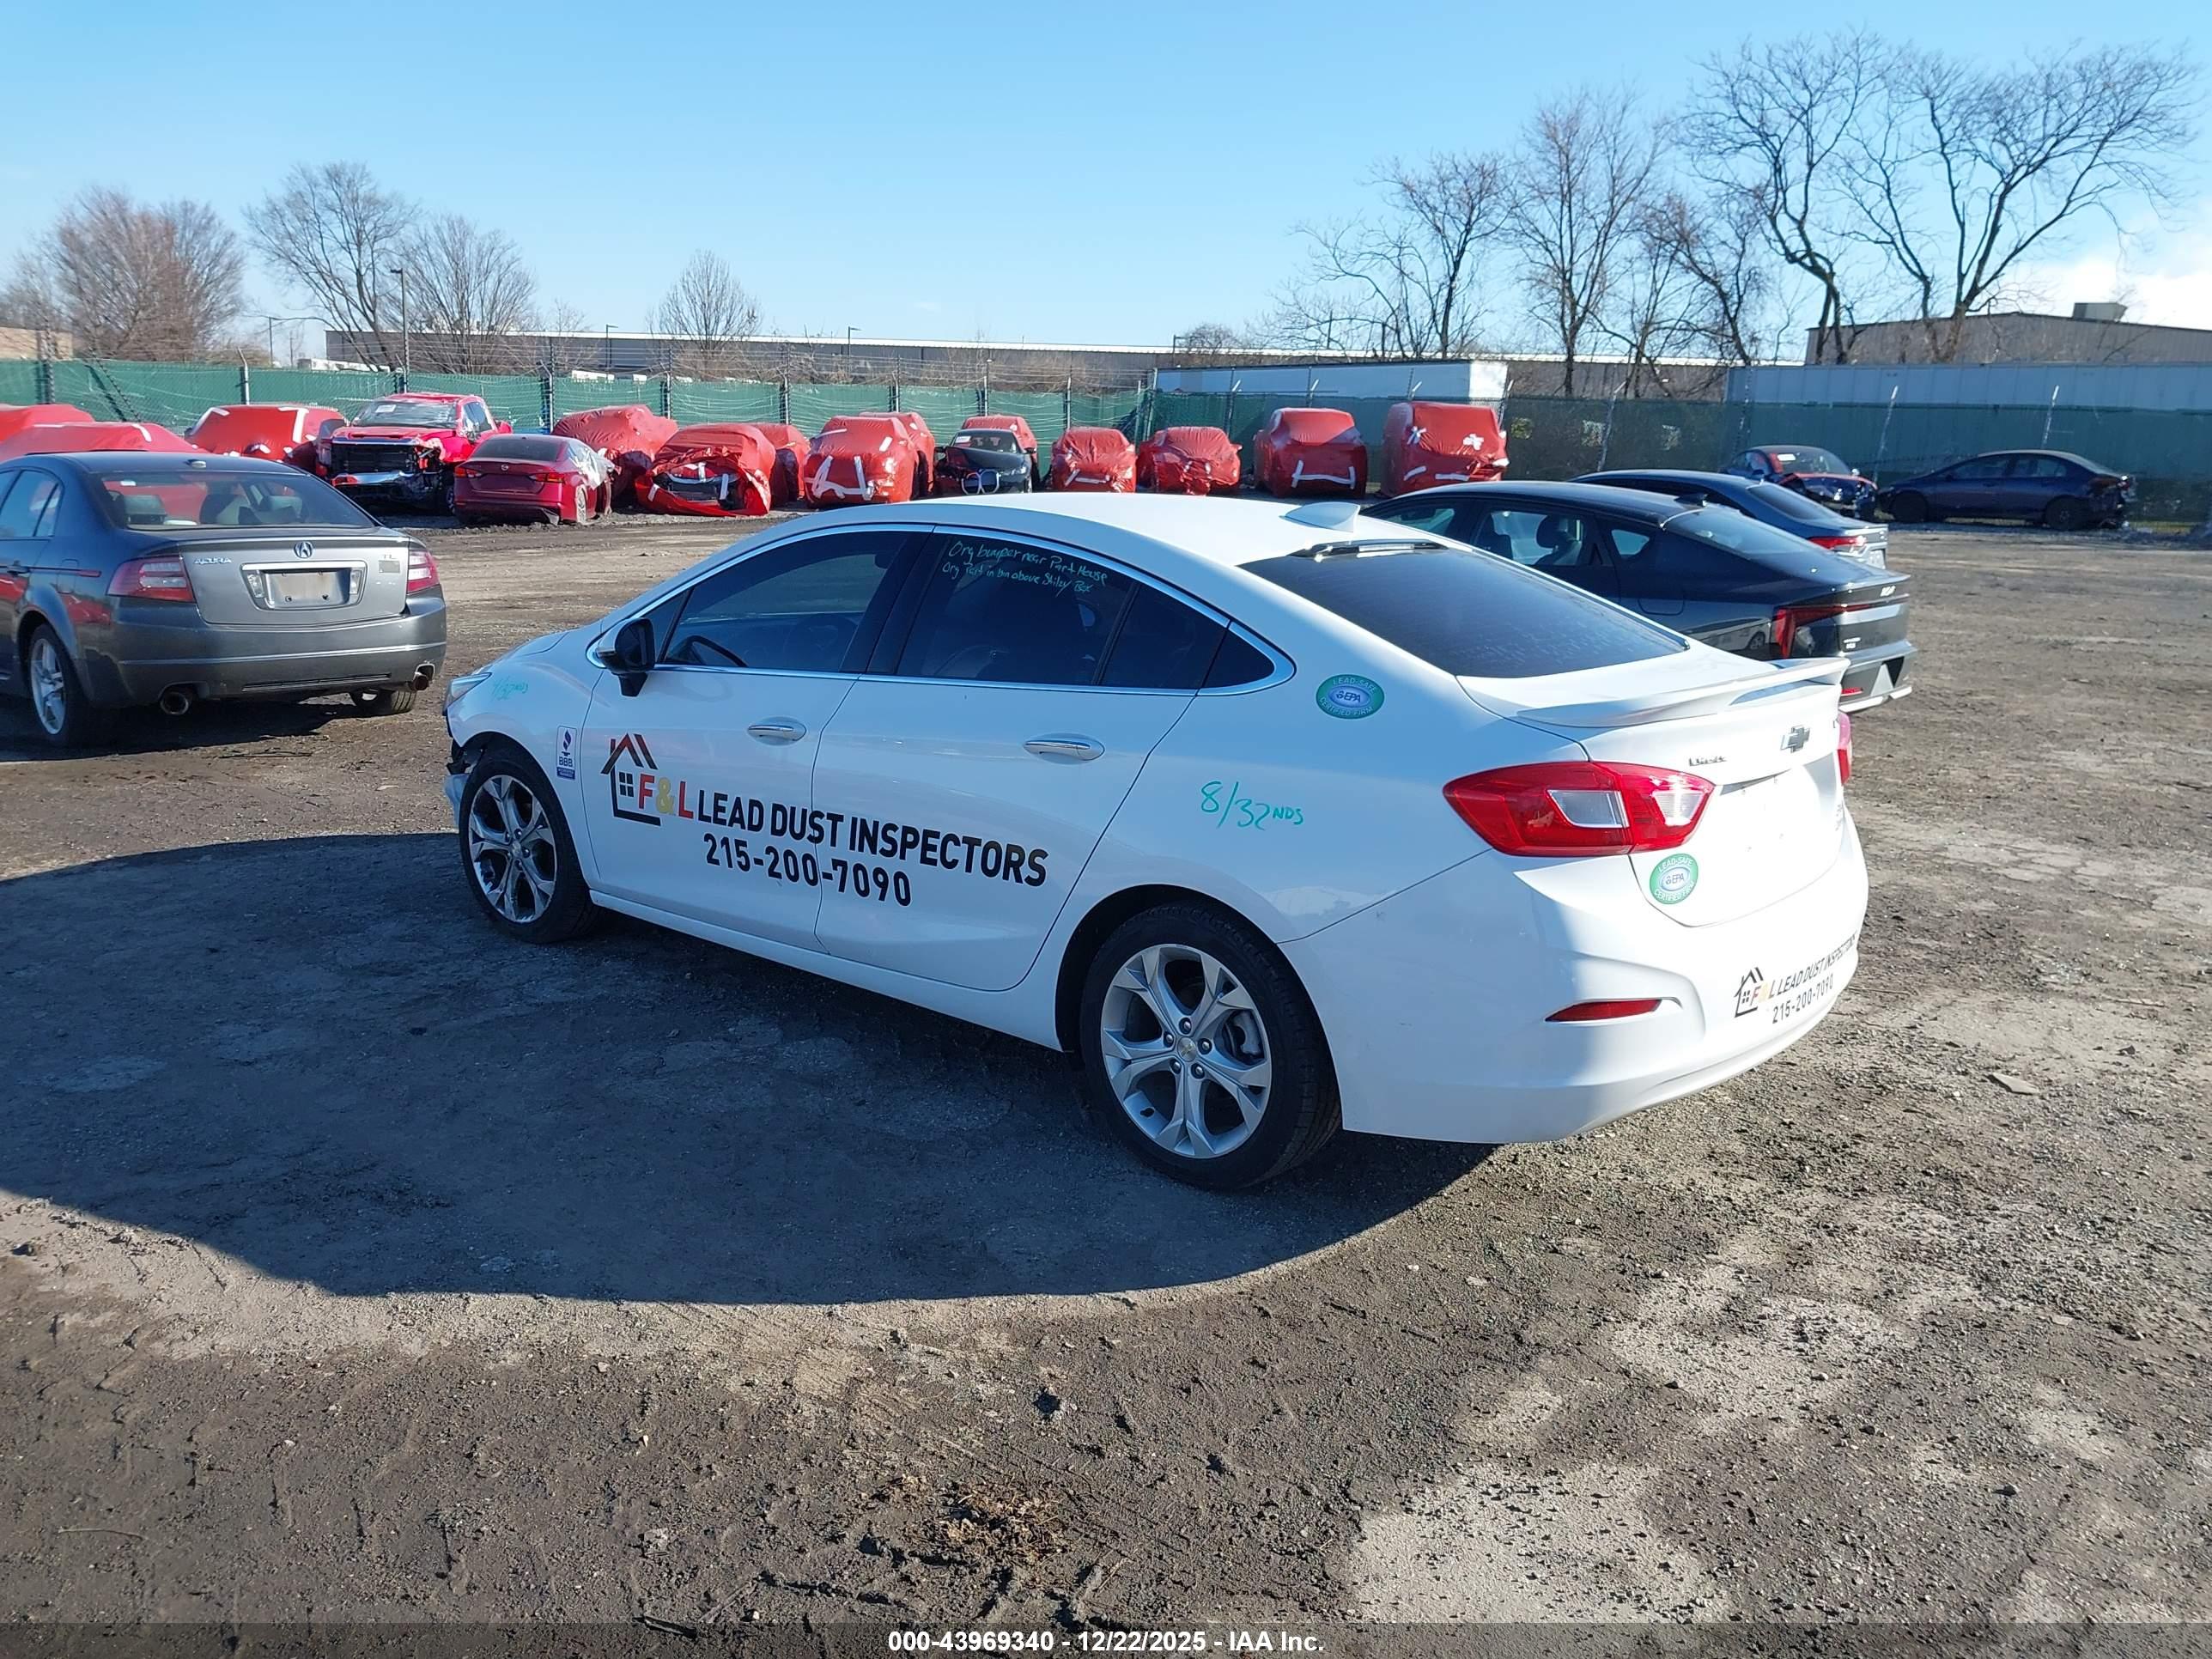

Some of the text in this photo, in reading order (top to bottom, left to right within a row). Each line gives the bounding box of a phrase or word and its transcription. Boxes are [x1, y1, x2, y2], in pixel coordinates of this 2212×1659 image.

[697, 788, 764, 833] LEAD
[771, 802, 844, 848] DUST
[849, 815, 1048, 888] INSPECTORS
[702, 832, 912, 907] 215-200-7090
[1772, 973, 1833, 1024] 215-200-7090
[1777, 970, 1803, 995] LEAD
[1803, 957, 1826, 983] DUST
